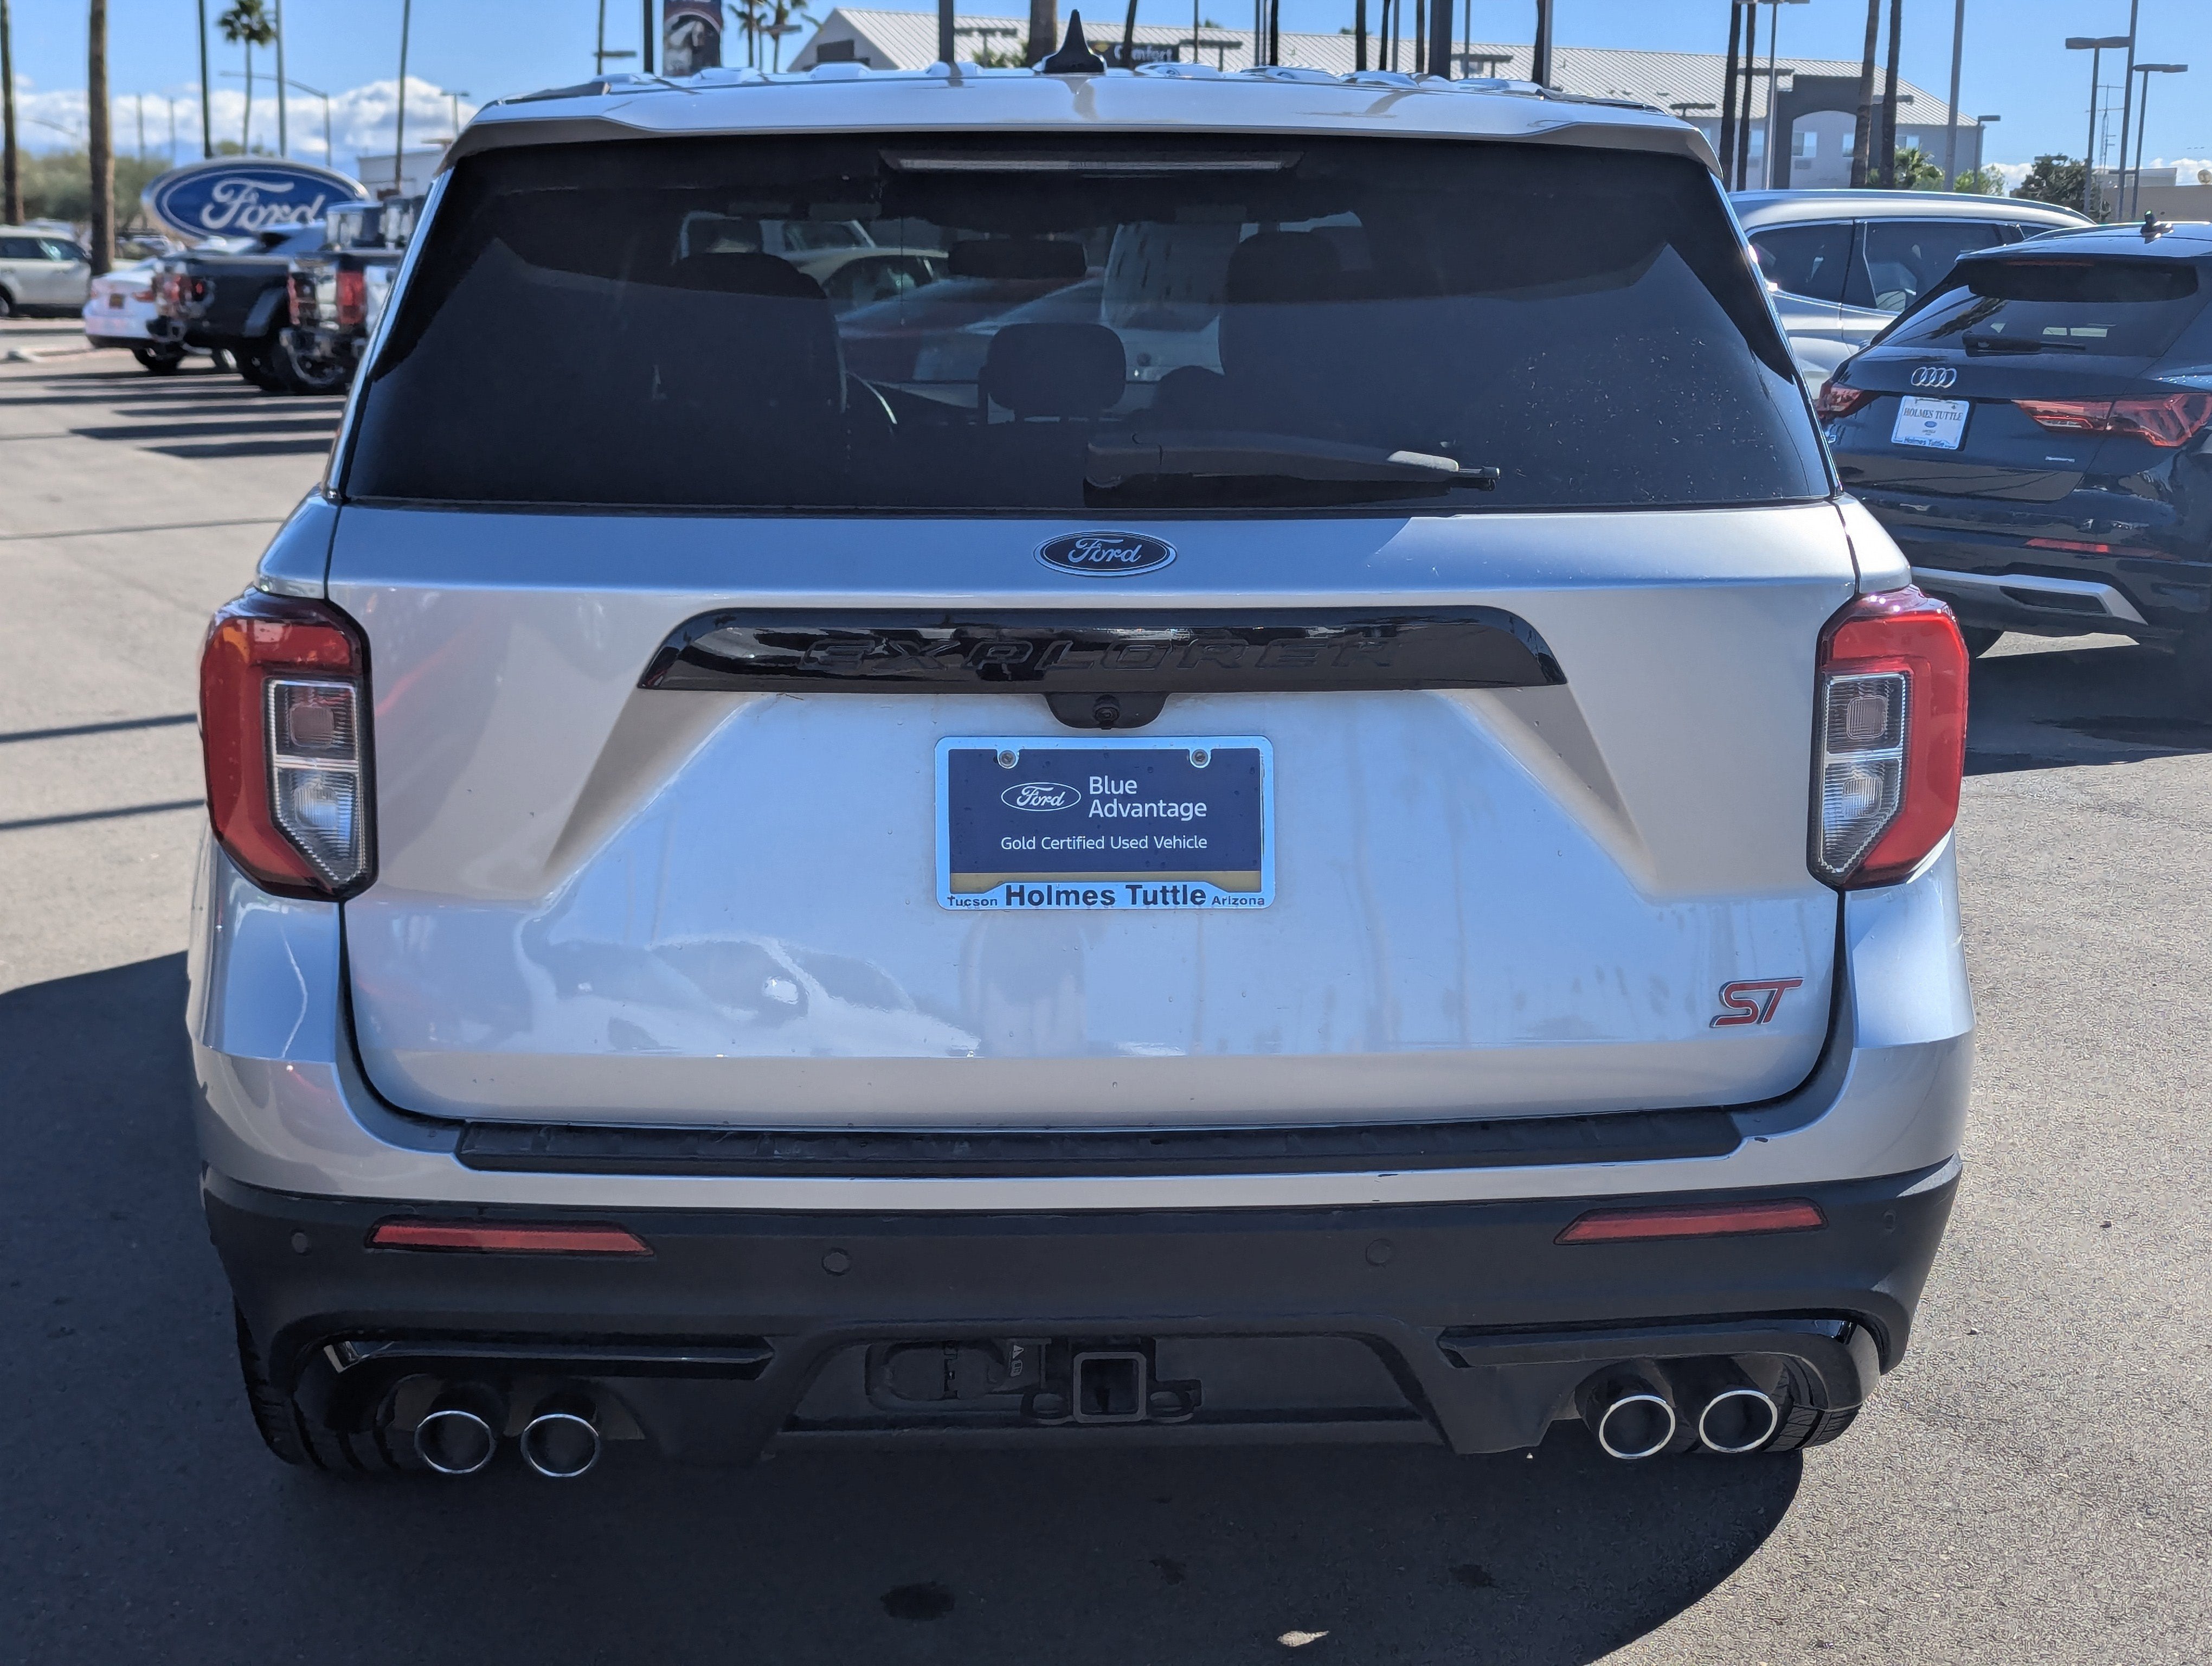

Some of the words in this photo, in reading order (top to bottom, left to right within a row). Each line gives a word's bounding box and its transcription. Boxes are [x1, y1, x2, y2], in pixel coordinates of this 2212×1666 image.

[1114, 44, 1173, 62] Cmfort
[201, 177, 325, 231] Ford
[1904, 408, 1933, 418] HOLMES
[1935, 411, 1963, 421] TUTTLE
[1068, 538, 1142, 562] Ford
[797, 637, 1392, 671] EXPLORER
[1017, 785, 1066, 807] Ford
[1089, 776, 1137, 794] Blue
[1089, 799, 1207, 821] Advantage
[1001, 836, 1036, 850] Gold
[1041, 836, 1105, 850] Certified
[1110, 836, 1148, 849] Used
[1154, 835, 1208, 849] Vehicle
[947, 895, 998, 907] Tucson
[1006, 885, 1116, 906] Holmes
[1126, 884, 1207, 906] Tuttle
[1211, 895, 1265, 906] Arizona
[1709, 976, 1804, 1028] ST
